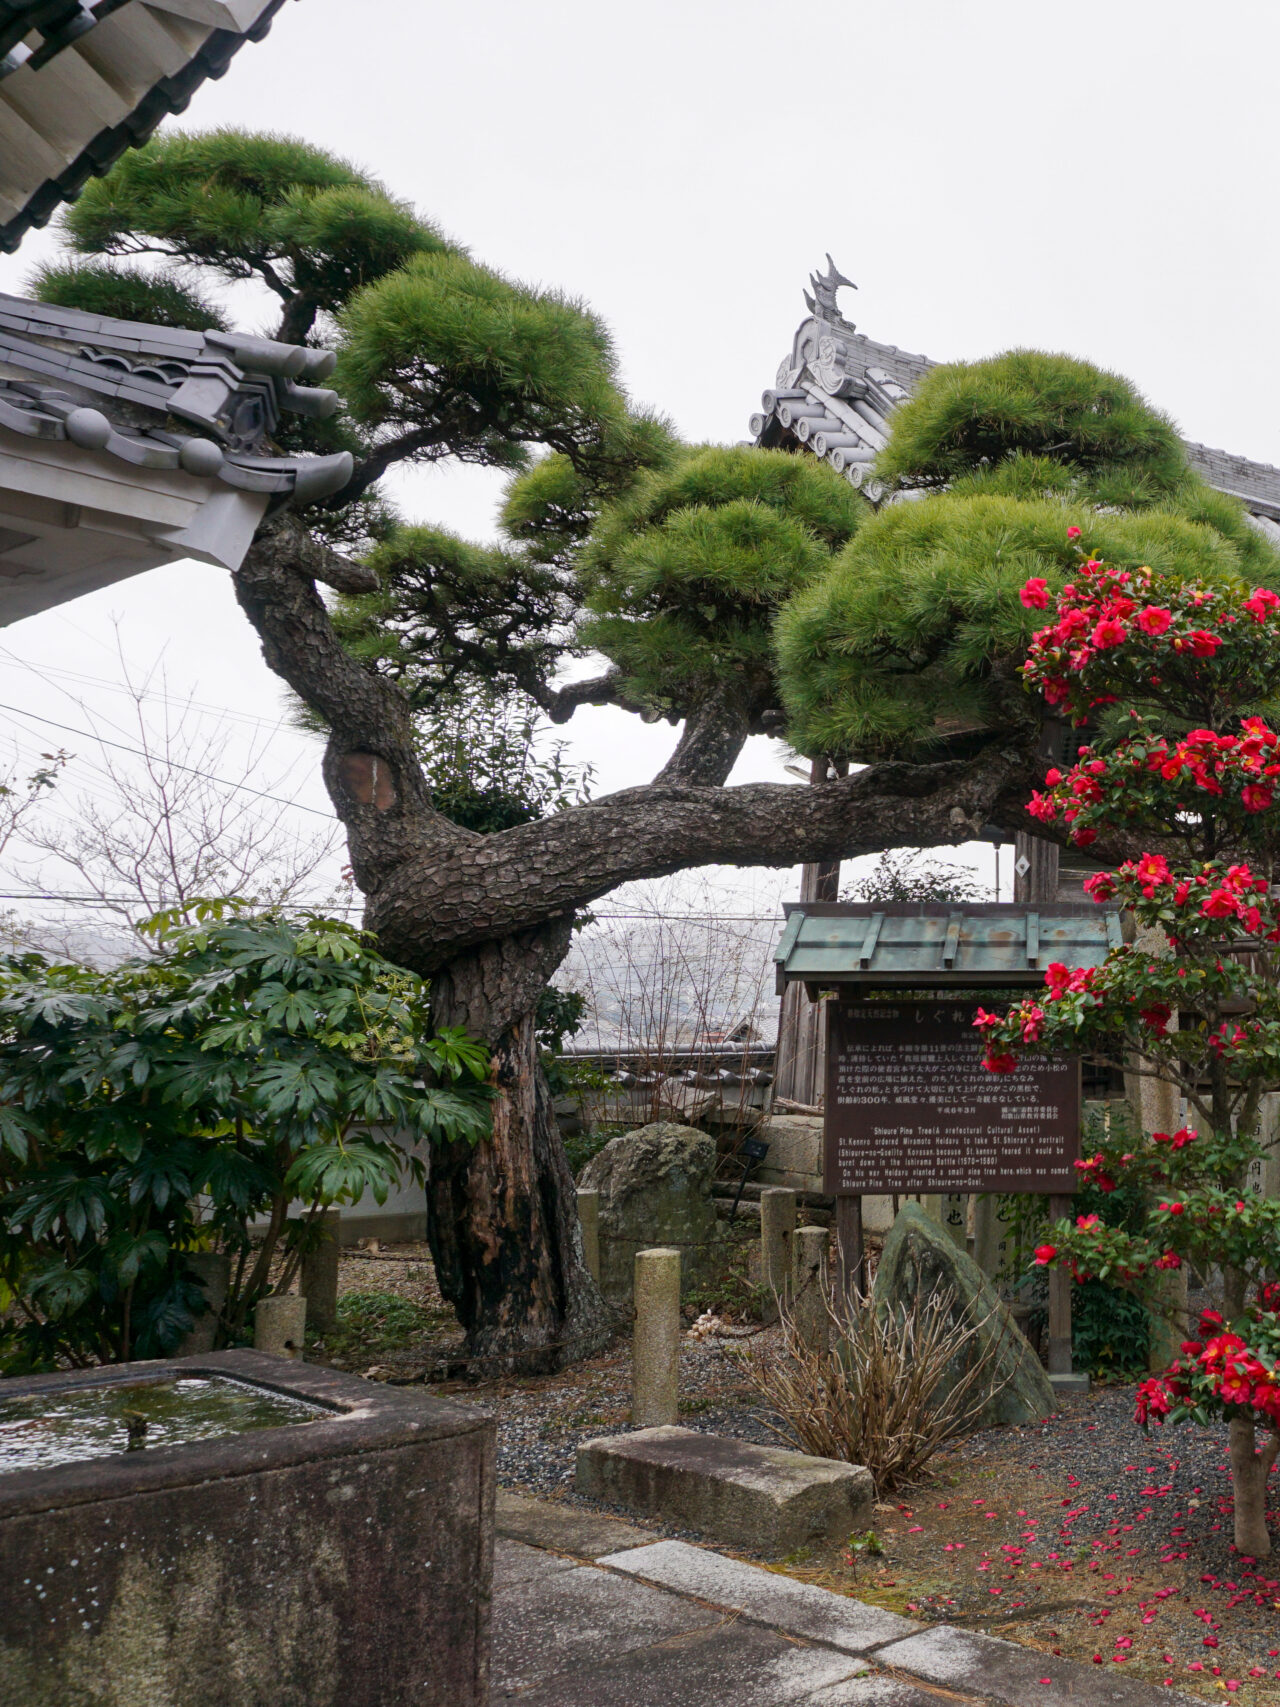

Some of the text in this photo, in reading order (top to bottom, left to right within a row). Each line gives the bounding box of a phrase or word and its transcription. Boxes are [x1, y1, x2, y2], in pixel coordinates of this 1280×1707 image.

[987, 1126, 1013, 1134] Cultural
[875, 1137, 899, 1145] ordered
[974, 1136, 988, 1144] take
[1002, 1147, 1021, 1155] feared
[1035, 1147, 1052, 1155] would
[838, 1159, 856, 1167] burnt
[890, 1158, 900, 1166] the
[948, 1168, 964, 1176] small
[984, 1168, 996, 1176] tree
[1050, 1167, 1069, 1175] named
[888, 1179, 902, 1187] Tree
[907, 1179, 923, 1187] after
